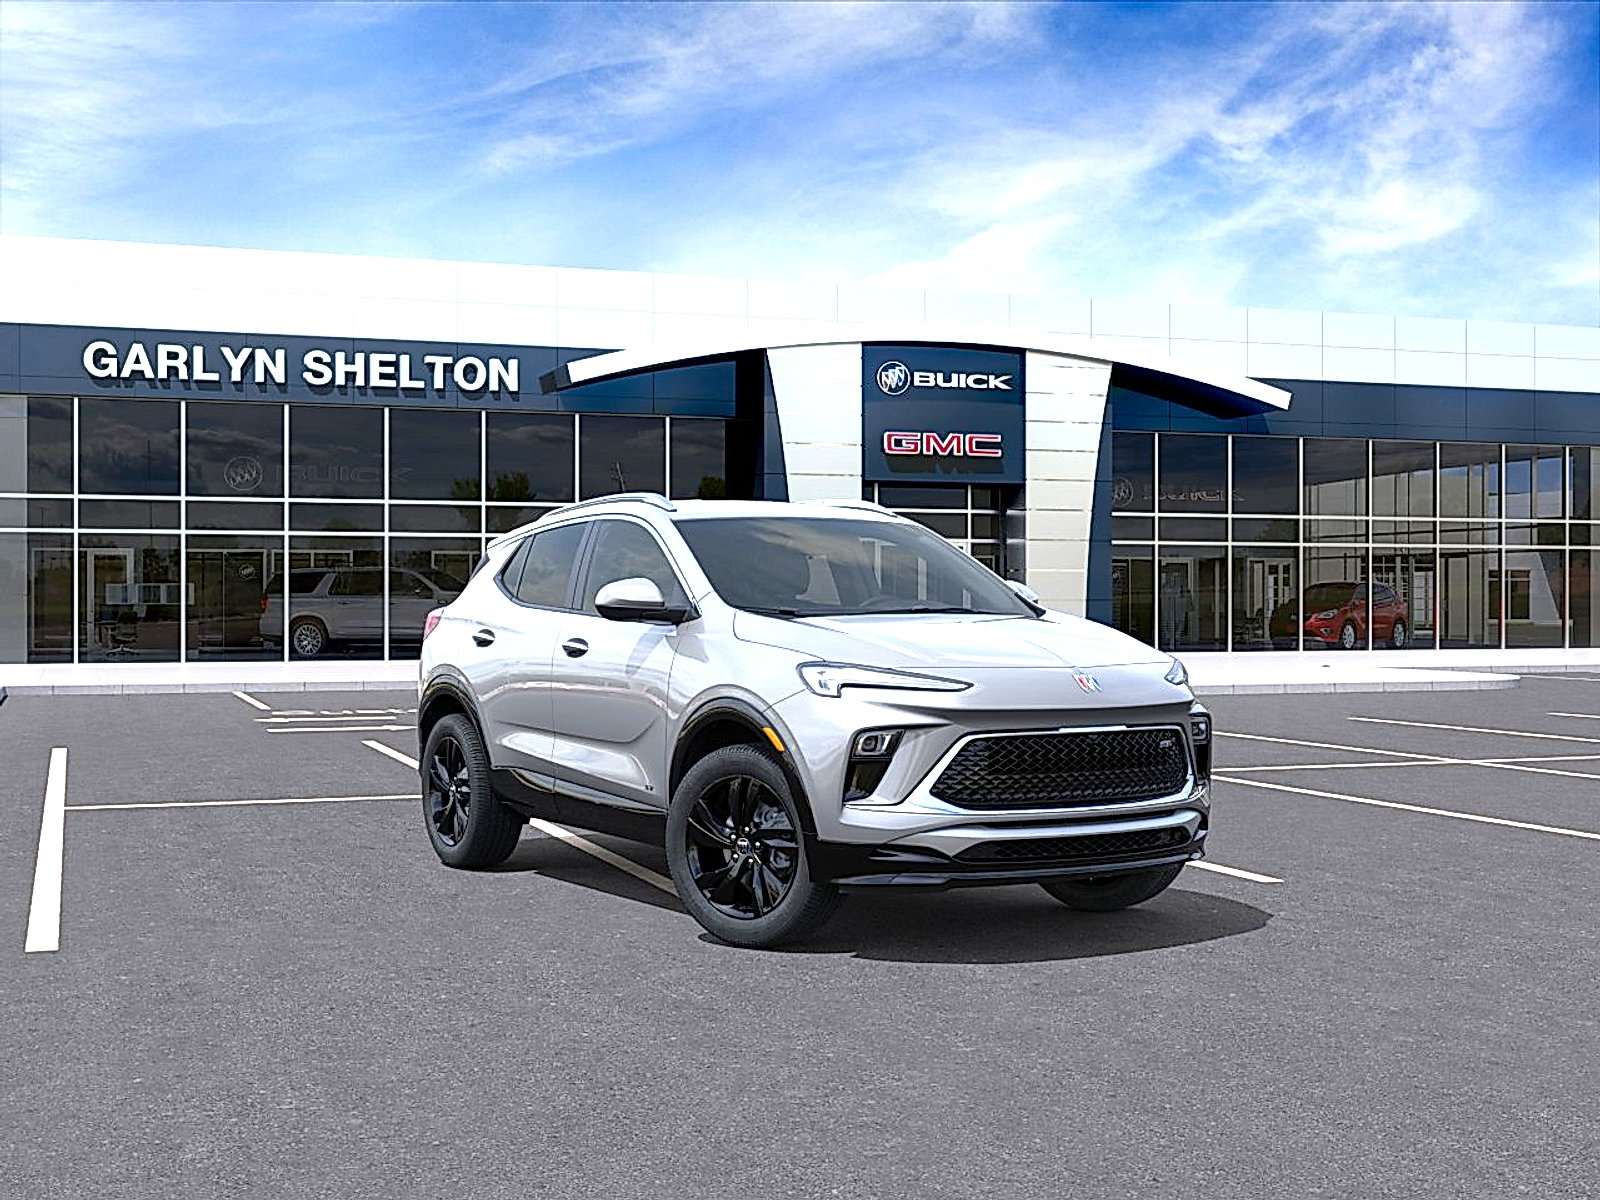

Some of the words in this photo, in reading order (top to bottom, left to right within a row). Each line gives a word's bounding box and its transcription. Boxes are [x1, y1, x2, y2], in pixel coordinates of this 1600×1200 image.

[83, 341, 286, 383] GARLYN
[302, 350, 519, 392] SHELTON
[913, 371, 1013, 390] BUICK
[883, 431, 1002, 457] GMC
